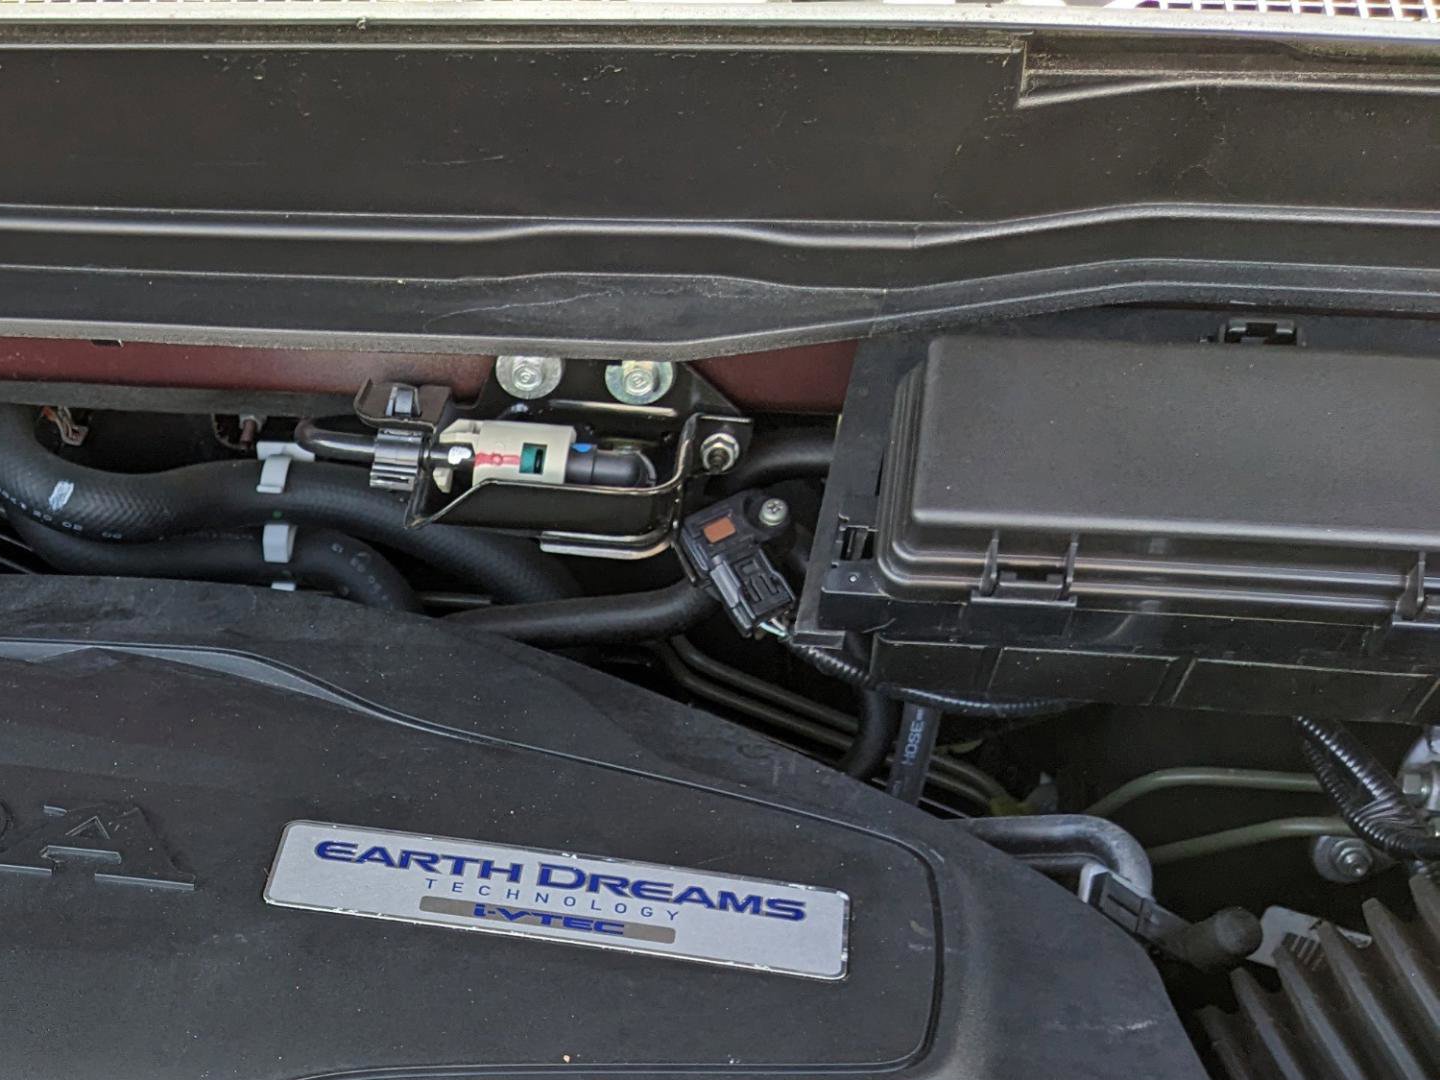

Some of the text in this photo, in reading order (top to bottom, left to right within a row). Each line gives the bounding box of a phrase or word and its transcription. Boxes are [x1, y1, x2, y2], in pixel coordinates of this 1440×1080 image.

[901, 720, 926, 765] HOSE
[314, 840, 806, 922] EARTH DREAMS
[425, 878, 679, 921] TECHNOLOGY
[473, 903, 624, 935] i-VTEC
